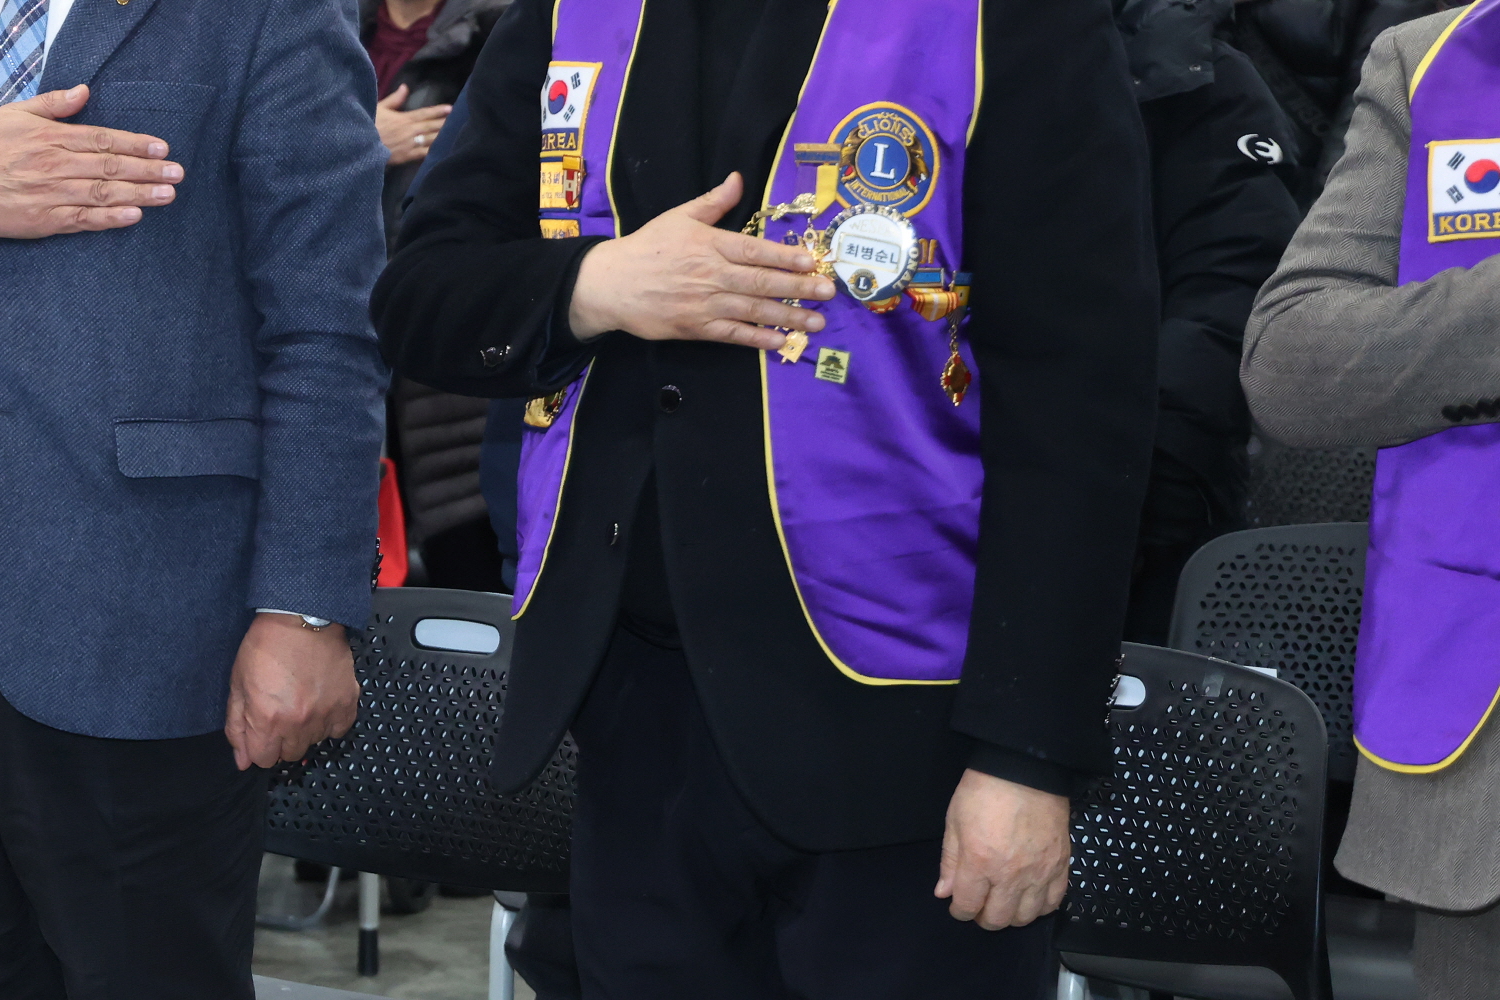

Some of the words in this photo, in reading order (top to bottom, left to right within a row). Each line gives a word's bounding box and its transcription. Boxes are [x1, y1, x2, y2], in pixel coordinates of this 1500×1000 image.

[862, 119, 911, 141] LIONS
[870, 142, 895, 179] L
[1439, 212, 1500, 234] KORE
